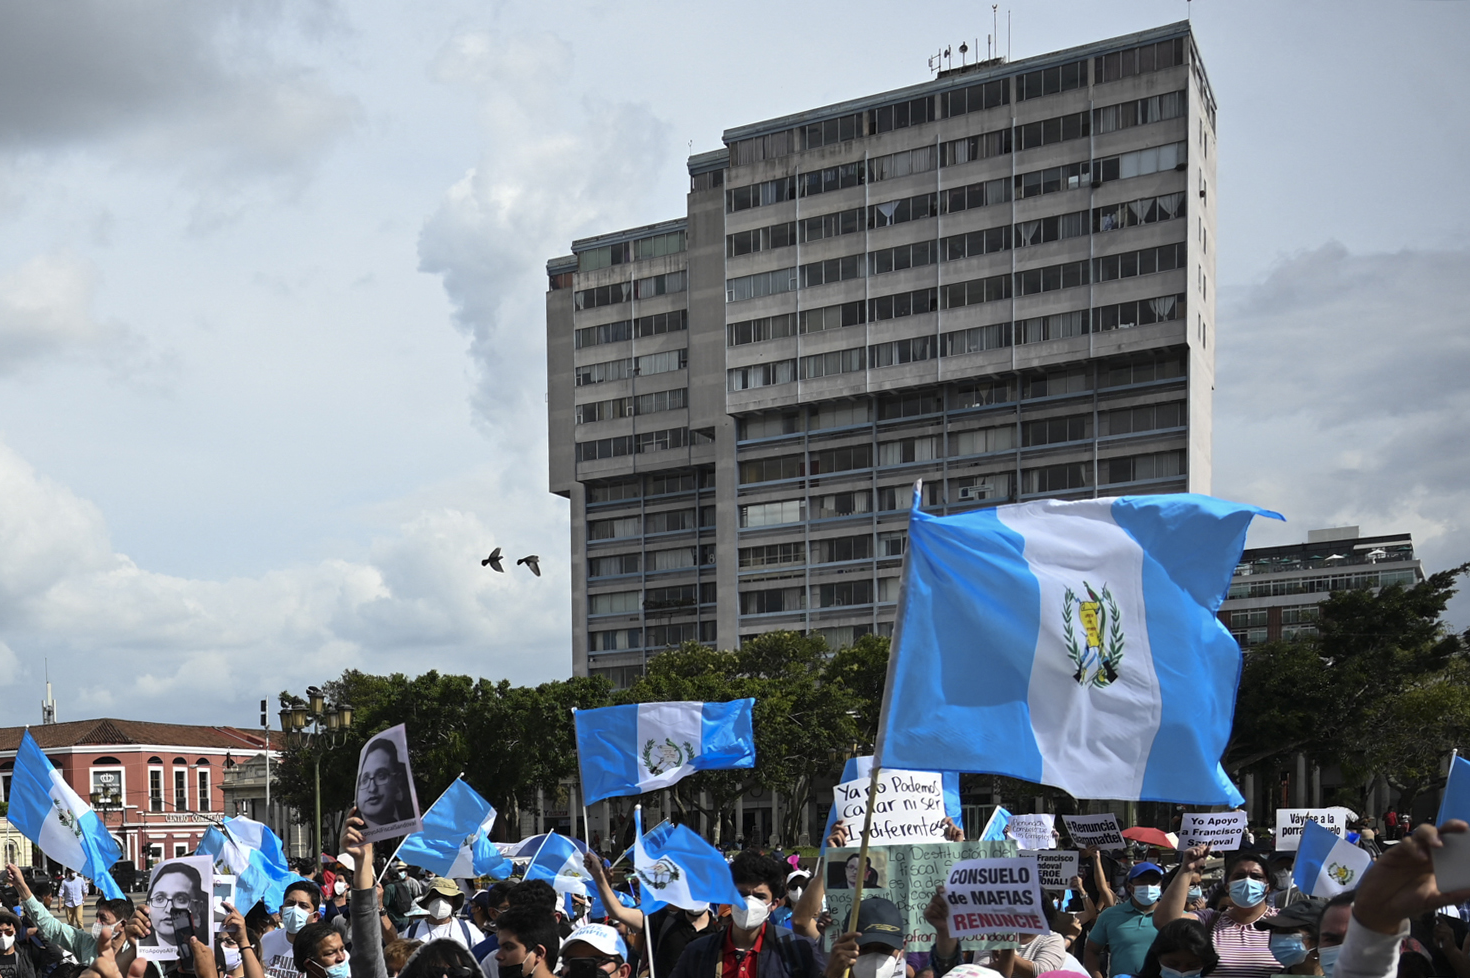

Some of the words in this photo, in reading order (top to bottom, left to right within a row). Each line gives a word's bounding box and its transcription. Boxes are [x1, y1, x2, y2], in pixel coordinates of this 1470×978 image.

[838, 785, 861, 801] Ya
[903, 799, 917, 811] ni
[166, 814, 188, 823] CENTRO
[1208, 818, 1238, 826] Apoyo
[1327, 814, 1334, 823] la
[1068, 821, 1117, 833] #Renuncia
[1192, 828, 1242, 836] Francisco
[1037, 853, 1074, 862] Francisco
[950, 867, 1030, 885] CONSUELO
[947, 891, 968, 905] de
[970, 889, 1034, 906] MAFIAS
[953, 912, 1044, 931] RENUNCIE
